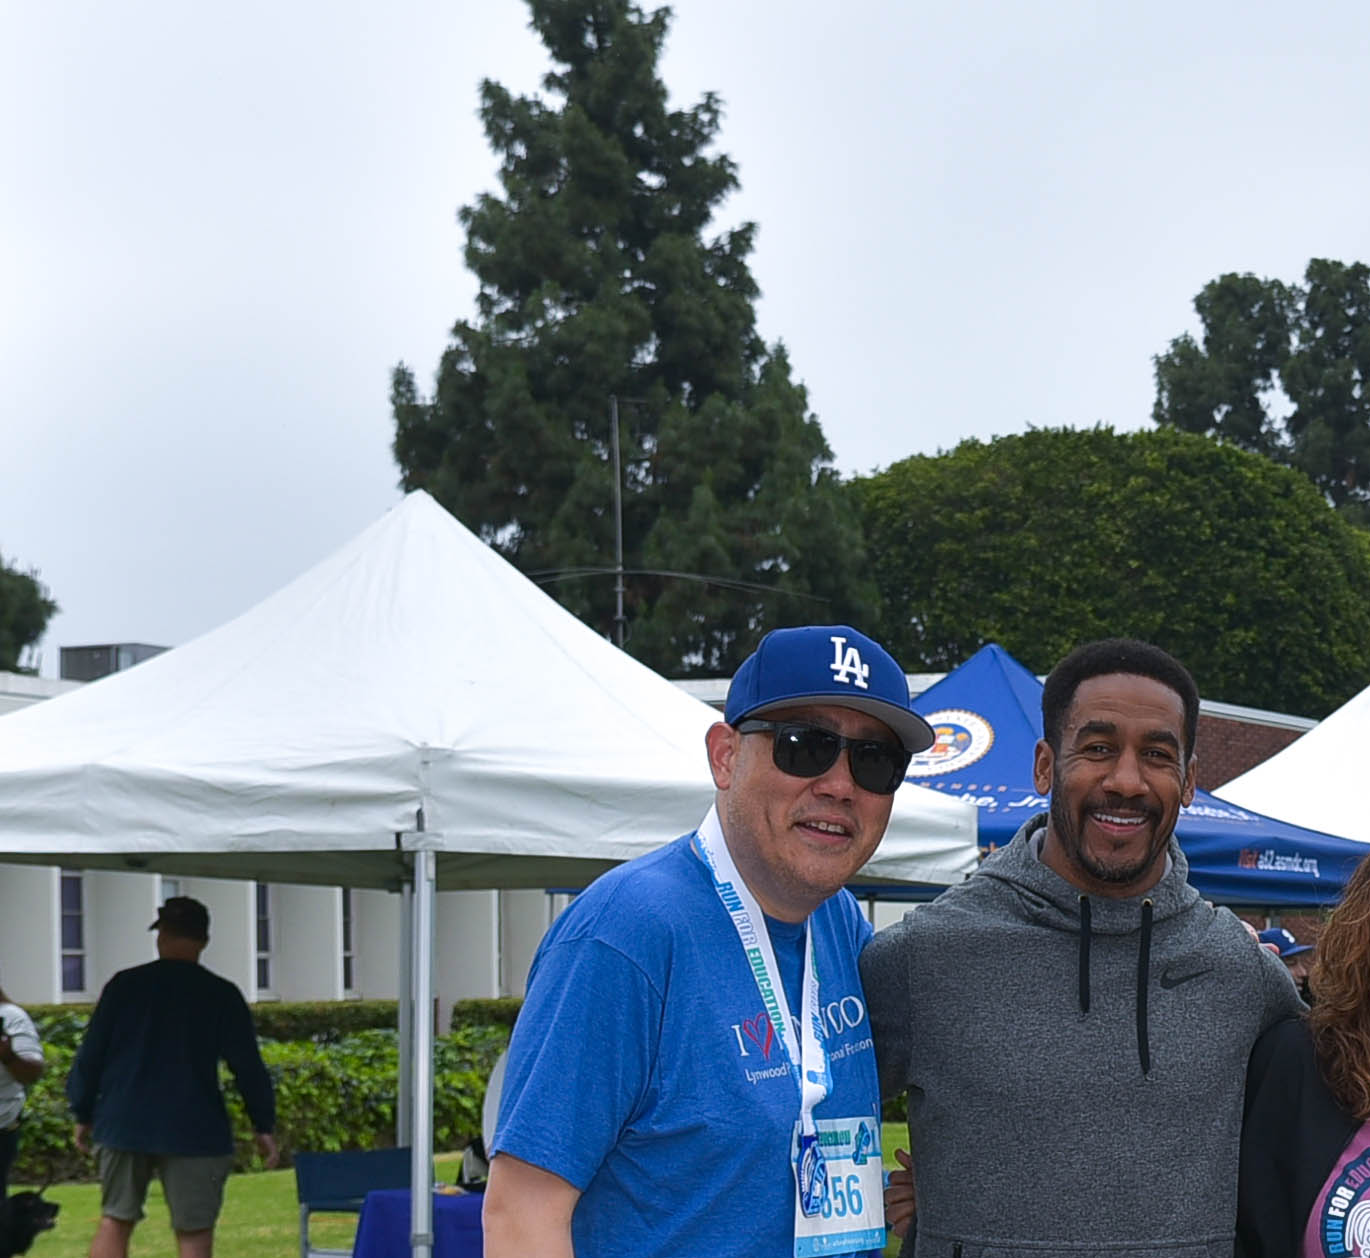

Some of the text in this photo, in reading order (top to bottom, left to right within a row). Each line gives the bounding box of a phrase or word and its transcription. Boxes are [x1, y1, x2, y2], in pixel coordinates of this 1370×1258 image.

[830, 636, 868, 689] LA
[717, 881, 745, 912] RUN
[748, 947, 788, 1034] EDUCATION
[745, 1063, 788, 1085] Lynwood
[1327, 1185, 1356, 1218] FOR
[1326, 1219, 1345, 1255] RUN
